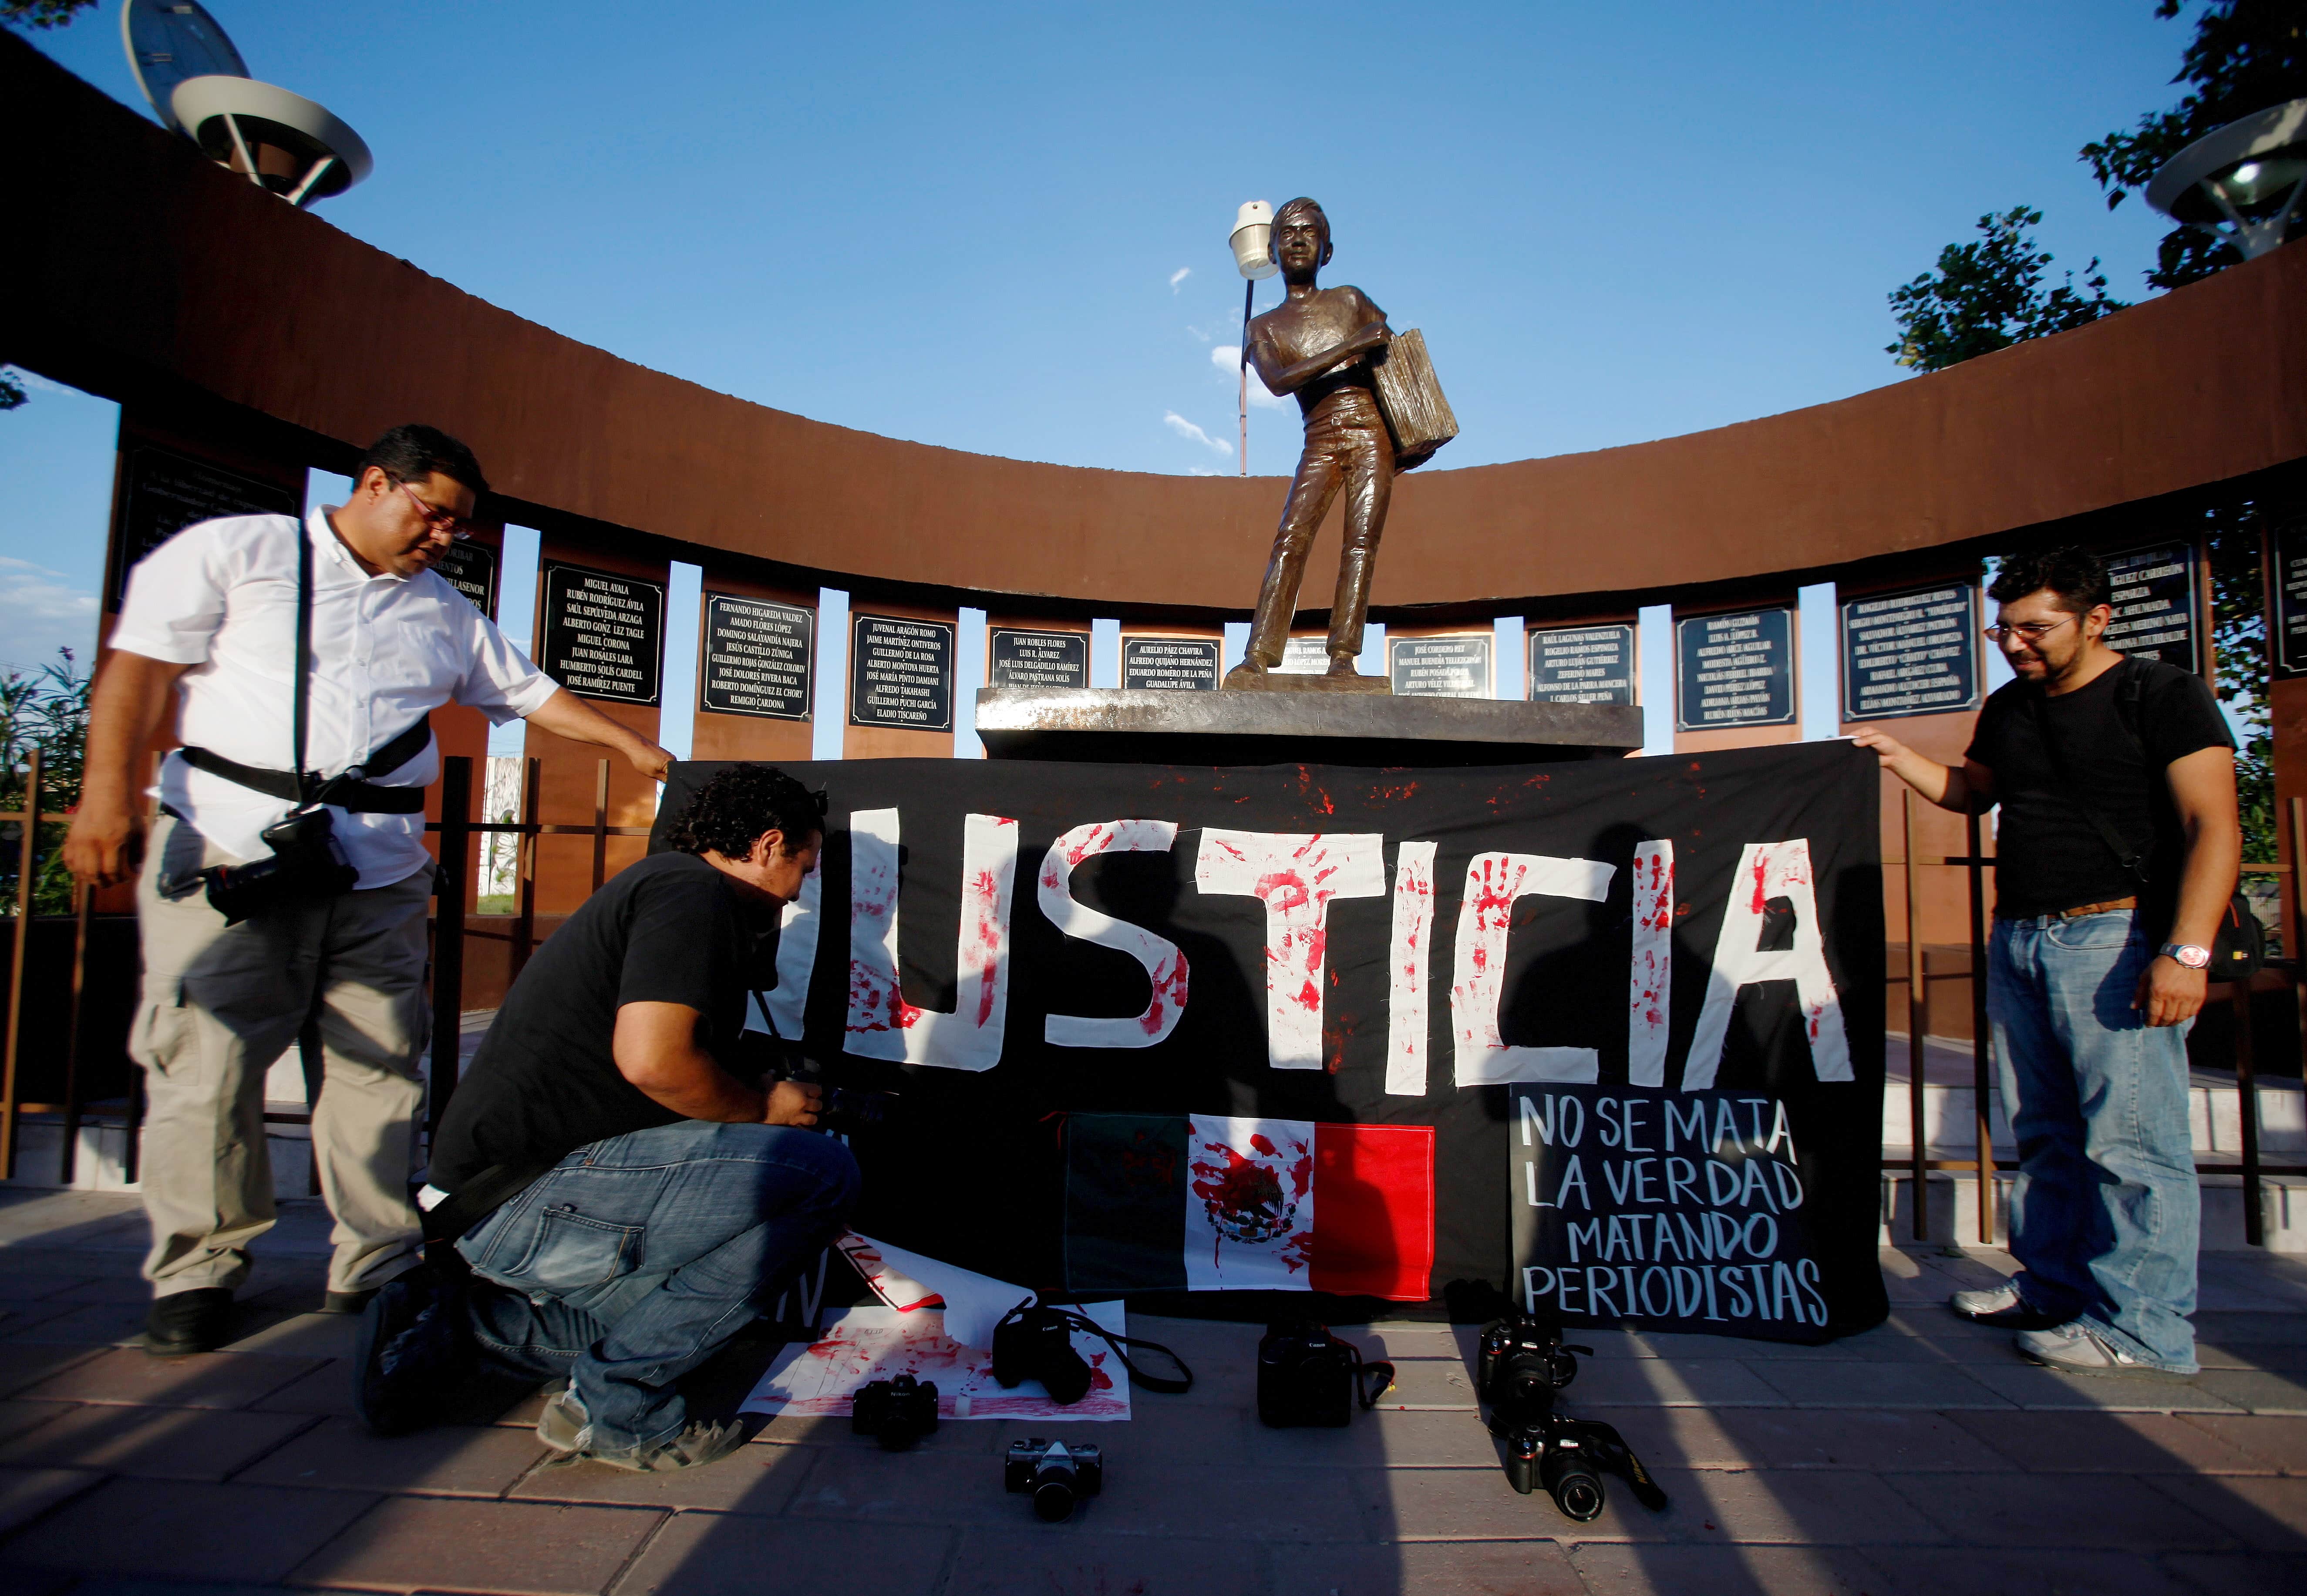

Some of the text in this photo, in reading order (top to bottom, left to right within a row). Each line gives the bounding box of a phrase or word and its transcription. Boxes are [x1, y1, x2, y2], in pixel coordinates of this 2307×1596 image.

[585, 579, 629, 594] MIGUEL AYALA
[567, 589, 643, 611] RUBÉN RODRÍGUEZ ÁVILA
[567, 603, 642, 624] SAÚL SEPÚLVEDA ARZAGA
[720, 603, 802, 623] FERNANDO HIGAREDA VALDEZ
[563, 617, 644, 638] ALBERTO TAGLE
[731, 618, 791, 634] AMADO FLORES LÓPEZ
[873, 624, 936, 637] JUVENAL ARAGÓN ROMO
[578, 634, 630, 650] MIGUEL CORONA
[717, 628, 802, 648] DOMINGO SALAYANDÍA NAJERA
[867, 635, 940, 650] JAIME MARTÍNEZ ONTIVEROS
[1014, 638, 1065, 648] JUAN ROBLES FLORES
[1559, 634, 1584, 643] LAGUNAS
[572, 647, 633, 664] JUAN ROSALES LARA
[726, 642, 792, 659] JESÚS CASTILLO ZÚNIGA
[873, 648, 903, 658] GUILLERMO
[905, 651, 912, 659] DE
[921, 653, 934, 661] ROSA
[1164, 646, 1177, 654] PÁEZ
[1415, 645, 1427, 654] JOSÉ
[1544, 646, 1569, 656] ROGELIO
[1570, 645, 1590, 654] RAMOS
[712, 654, 805, 673] GUILLERMO ROJAS GONZÁLEZ COLORIN
[867, 660, 939, 673] ALBERTO MONTOYA HUERTA
[999, 659, 1010, 668] JOSÉ
[1024, 661, 1055, 670] DELGADILLO
[1057, 662, 1079, 671] RAMÍREZ
[1155, 658, 1179, 666] QUIJANO
[1180, 657, 1212, 667] HERNÁNDEZ
[1545, 659, 1567, 668] ARTURO
[560, 660, 643, 679] HUMBERTO SOLÍS CARDELL
[719, 667, 797, 684] JOSÉ DOLORES RIVERA BACA
[1008, 671, 1069, 682] ÁLVARO PASTRANA SOLÍS
[1199, 669, 1212, 678] PEÑA
[1411, 668, 1428, 677] RUBÉN
[567, 675, 635, 692] JOSÉ RAMÍREZ PUENTE
[866, 671, 939, 685] JOSÉ MARÍA PINTO DAMIANI
[1179, 680, 1195, 689] ÁVILA
[712, 680, 803, 698] ROBERTO DOMÍNGUEZ EL CHORY
[876, 685, 930, 697] ALFREDO TAKAHASHI
[1537, 683, 1562, 692] ALFONSO
[1580, 681, 1598, 689] PARRA
[731, 695, 784, 709] REMIGIO CARDONA
[867, 696, 937, 709] GUILLERMO PUCHI GARCÍA
[877, 709, 926, 720] ELADIO TISCAREÑO
[1520, 1094, 1798, 1165] NO SE MATA
[1525, 1155, 1804, 1215] LA VERDAD
[1567, 1211, 1778, 1263] MATANDO
[1522, 1259, 1828, 1327] PERIODISTAS
[1559, 1439, 1579, 1448] Nikon
